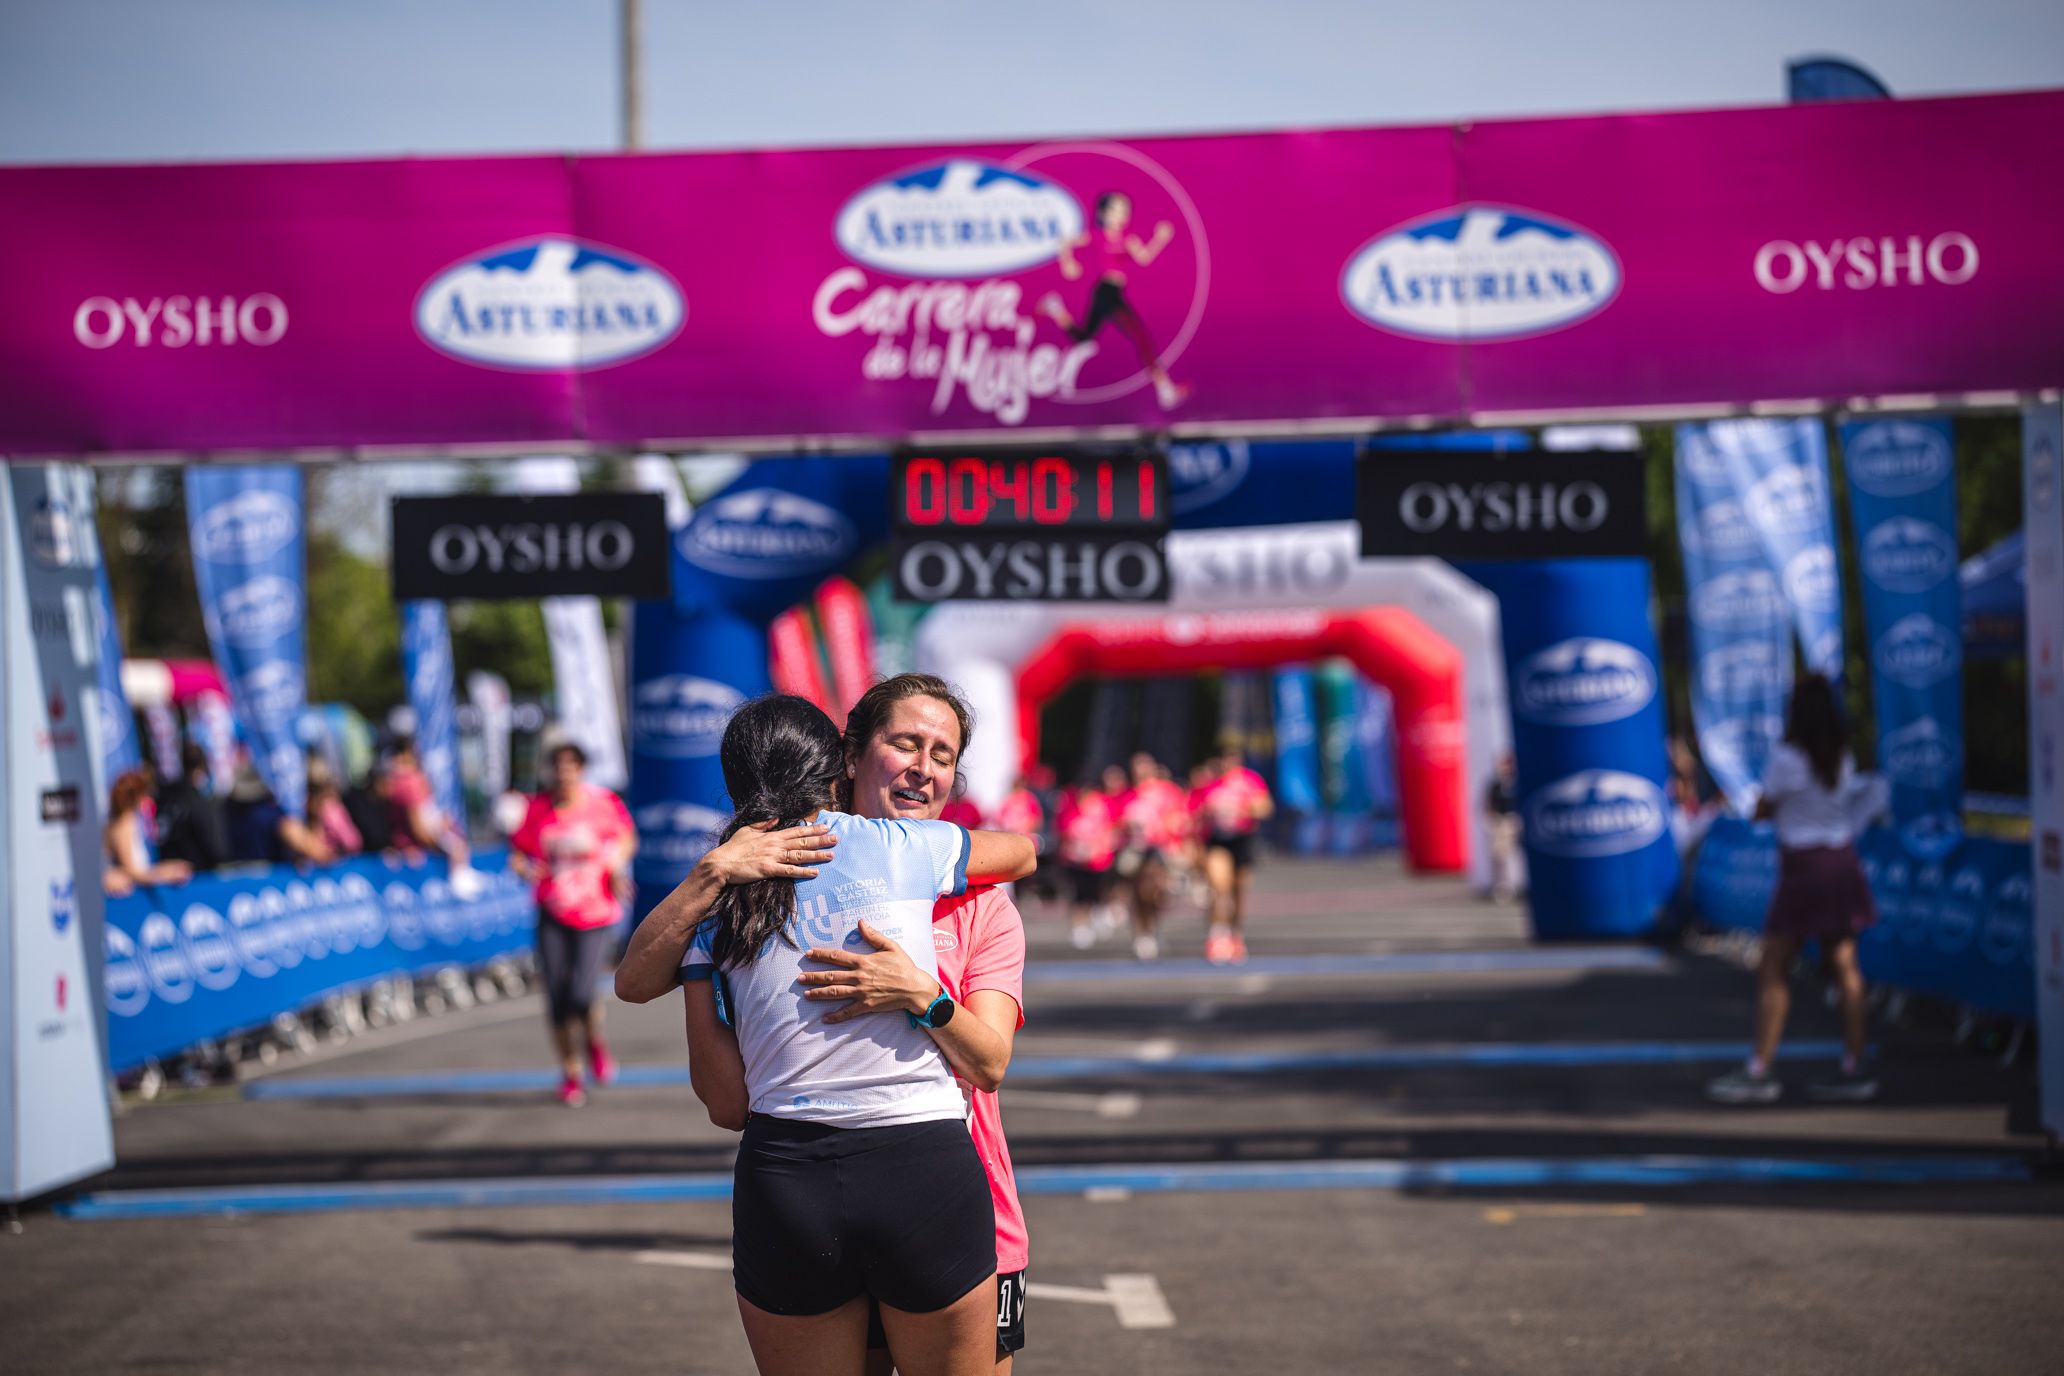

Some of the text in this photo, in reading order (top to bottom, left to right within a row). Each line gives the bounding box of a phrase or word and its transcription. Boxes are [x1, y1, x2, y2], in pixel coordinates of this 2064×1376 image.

[1364, 259, 1599, 307] ASTURIANA
[1753, 231, 1980, 294] OYSHO
[73, 293, 289, 348] OYSHO
[441, 288, 664, 341] ASTURIANA
[1400, 480, 1608, 532] OYSHO
[429, 520, 635, 575] OYSHO
[900, 540, 1162, 600] OYSHO
[834, 876, 888, 894] VITORIA
[837, 886, 889, 902] GASTEIZ
